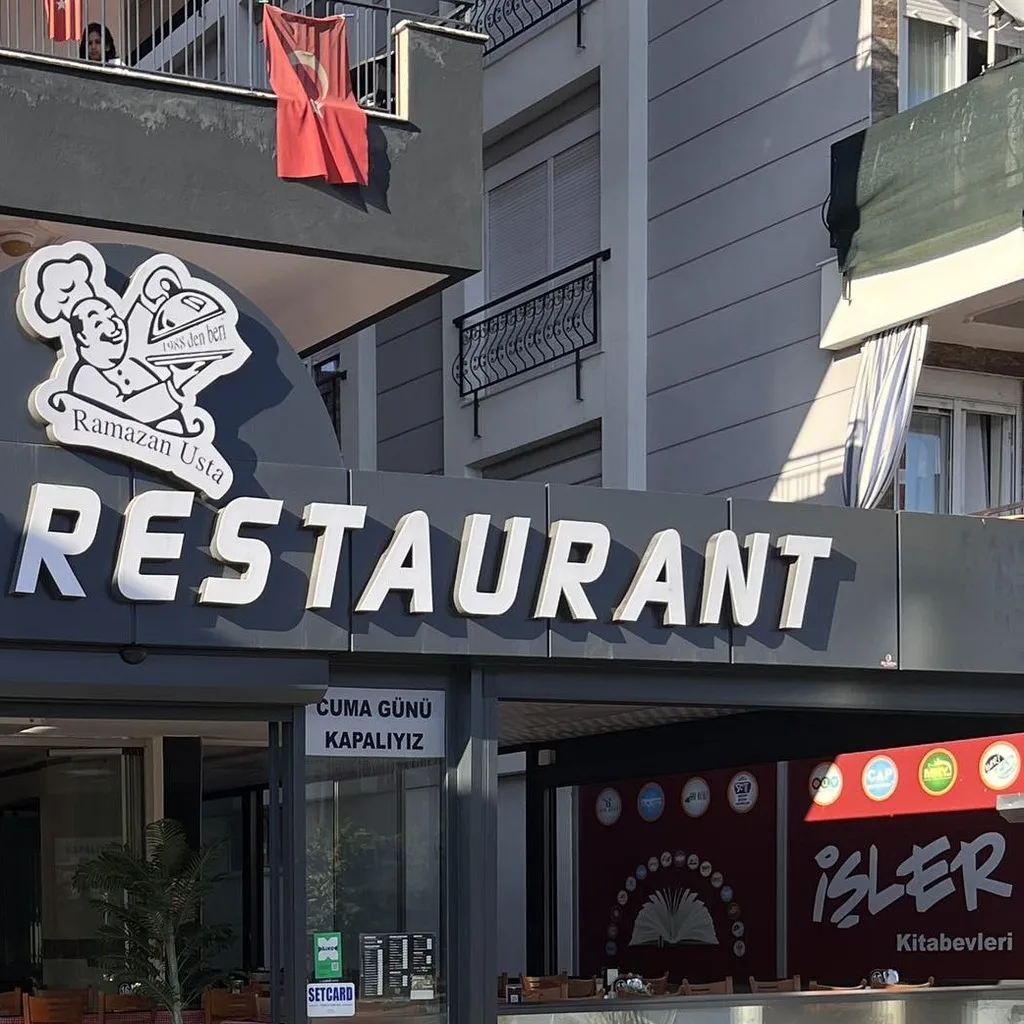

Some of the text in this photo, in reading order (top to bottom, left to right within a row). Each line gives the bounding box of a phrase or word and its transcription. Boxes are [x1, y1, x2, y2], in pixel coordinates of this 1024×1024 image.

[186, 331, 206, 348] den
[72, 408, 224, 485] Ramazan Usta
[9, 483, 834, 631] RESTAURANT
[316, 697, 432, 719] CUMA GÜNÜ
[325, 731, 424, 750] KAPALIYIZ
[896, 932, 1013, 952] Kitabevleri
[308, 986, 353, 1002] SETCARD
